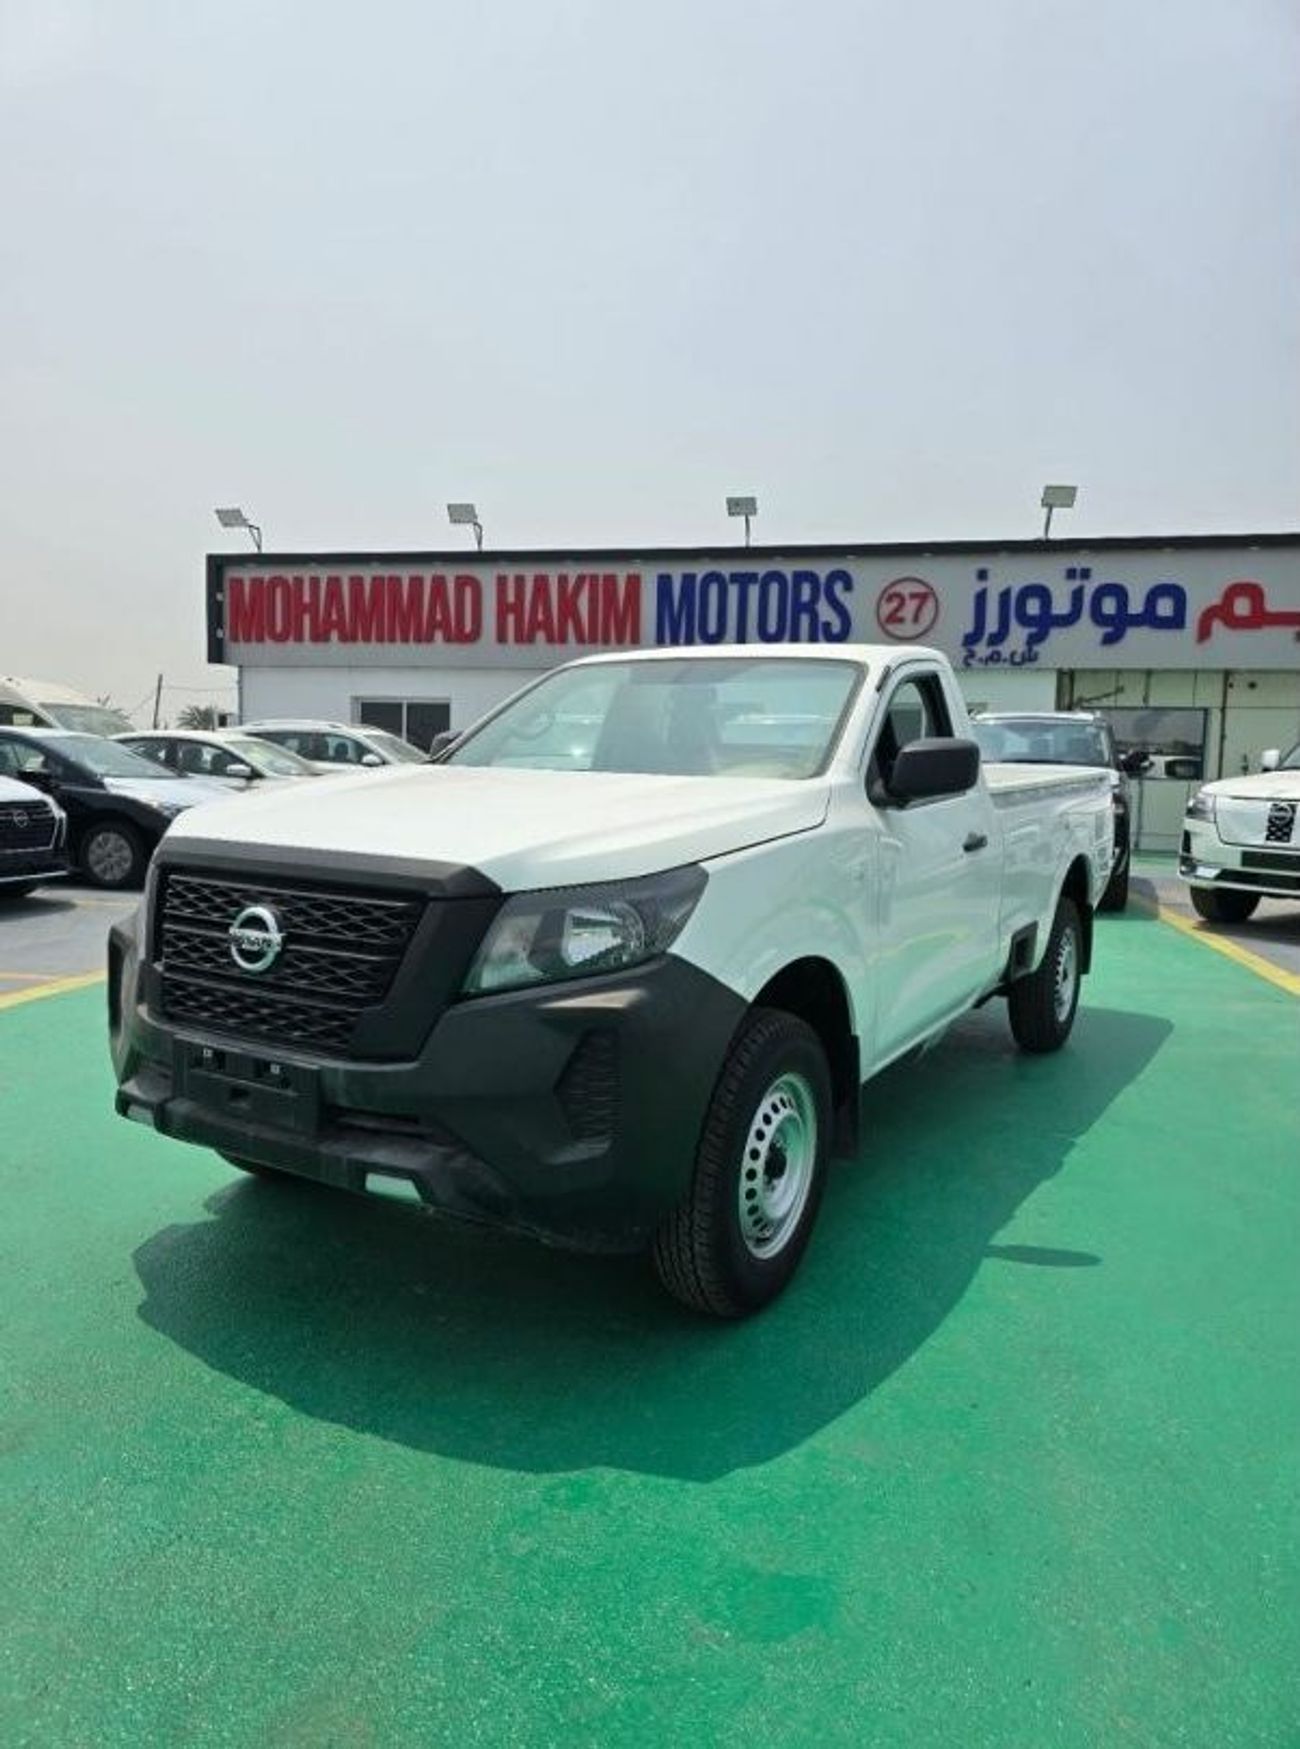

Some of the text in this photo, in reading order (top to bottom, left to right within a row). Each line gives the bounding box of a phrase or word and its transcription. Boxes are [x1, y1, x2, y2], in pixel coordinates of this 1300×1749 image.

[228, 569, 853, 645] MOHAMMAD HAKIM MOTORS
[883, 591, 930, 625] 27
[962, 567, 1187, 647] موتورز
